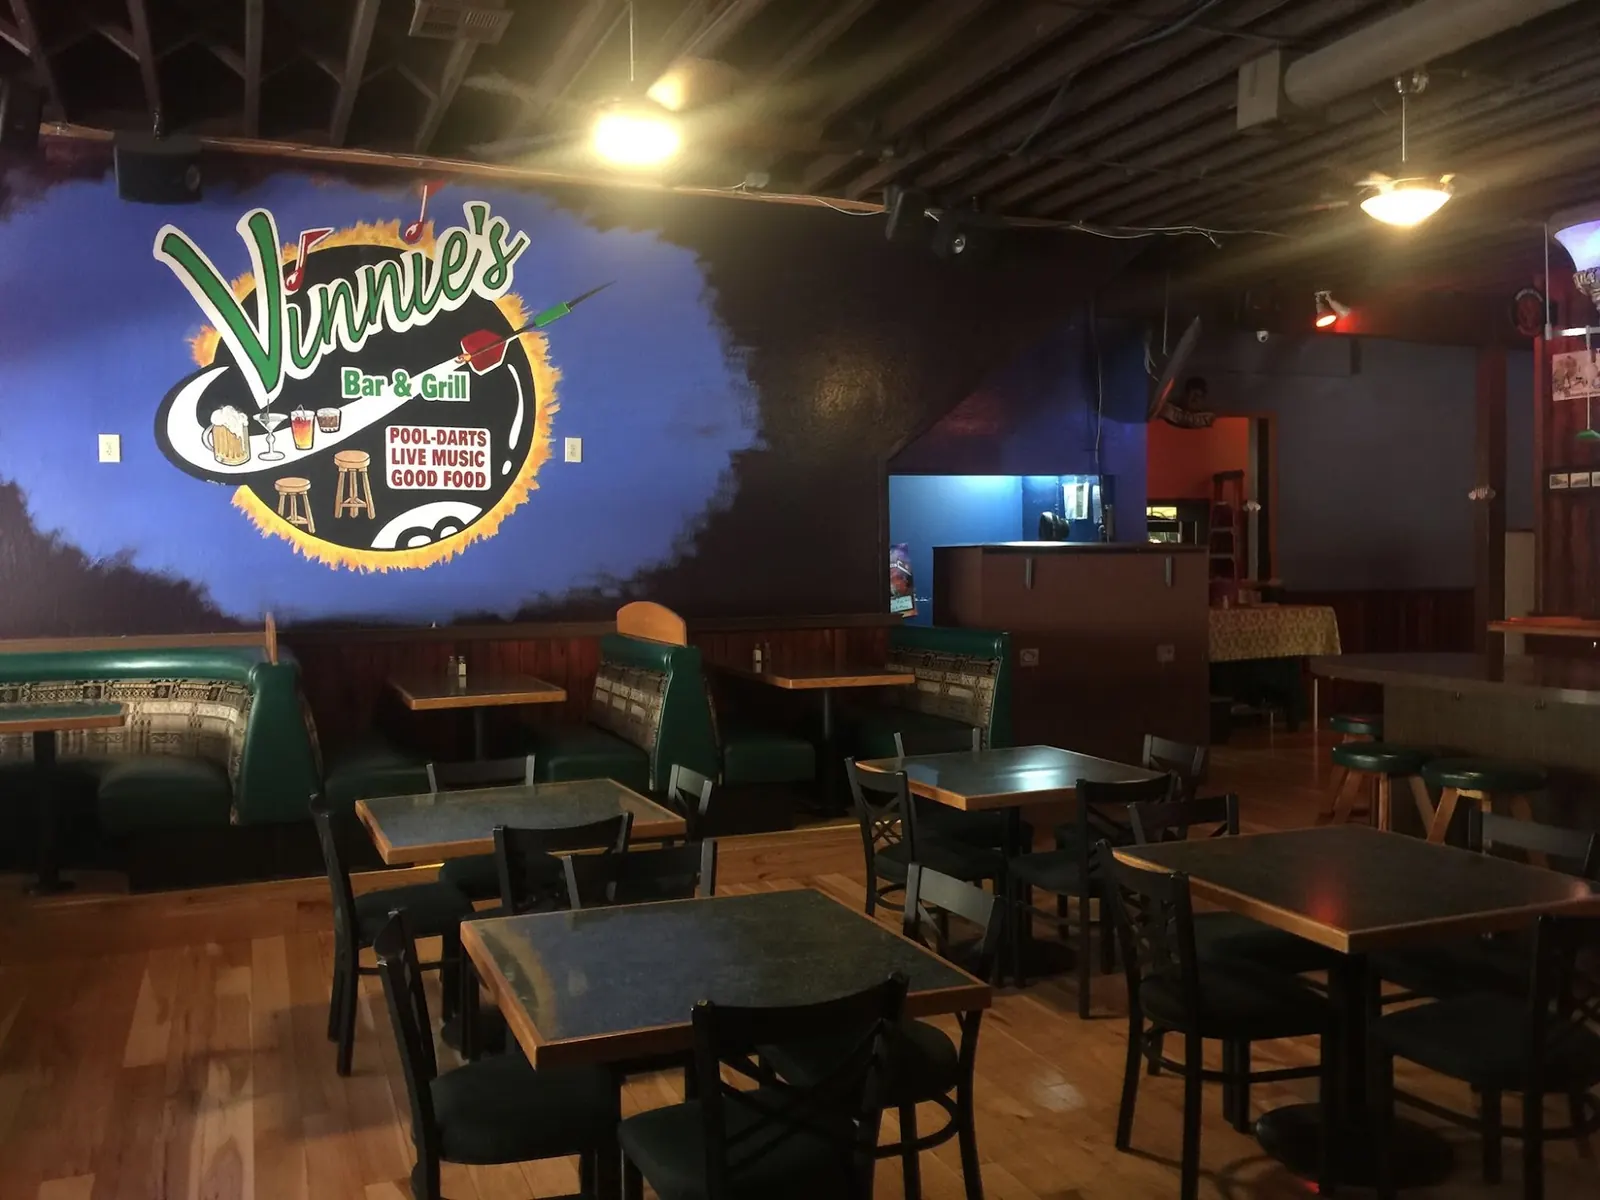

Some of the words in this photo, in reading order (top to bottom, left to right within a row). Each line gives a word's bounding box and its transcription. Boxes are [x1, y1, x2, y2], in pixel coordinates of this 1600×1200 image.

[157, 203, 529, 401] Vinnie's
[344, 370, 384, 397] Bar
[393, 371, 412, 397] &
[421, 373, 467, 399] Grill
[389, 427, 487, 447] POOL-DARTS
[391, 448, 427, 466] LIVE
[432, 449, 485, 468] MUSIC
[391, 469, 438, 487] GOOD
[443, 470, 486, 488] FOOD
